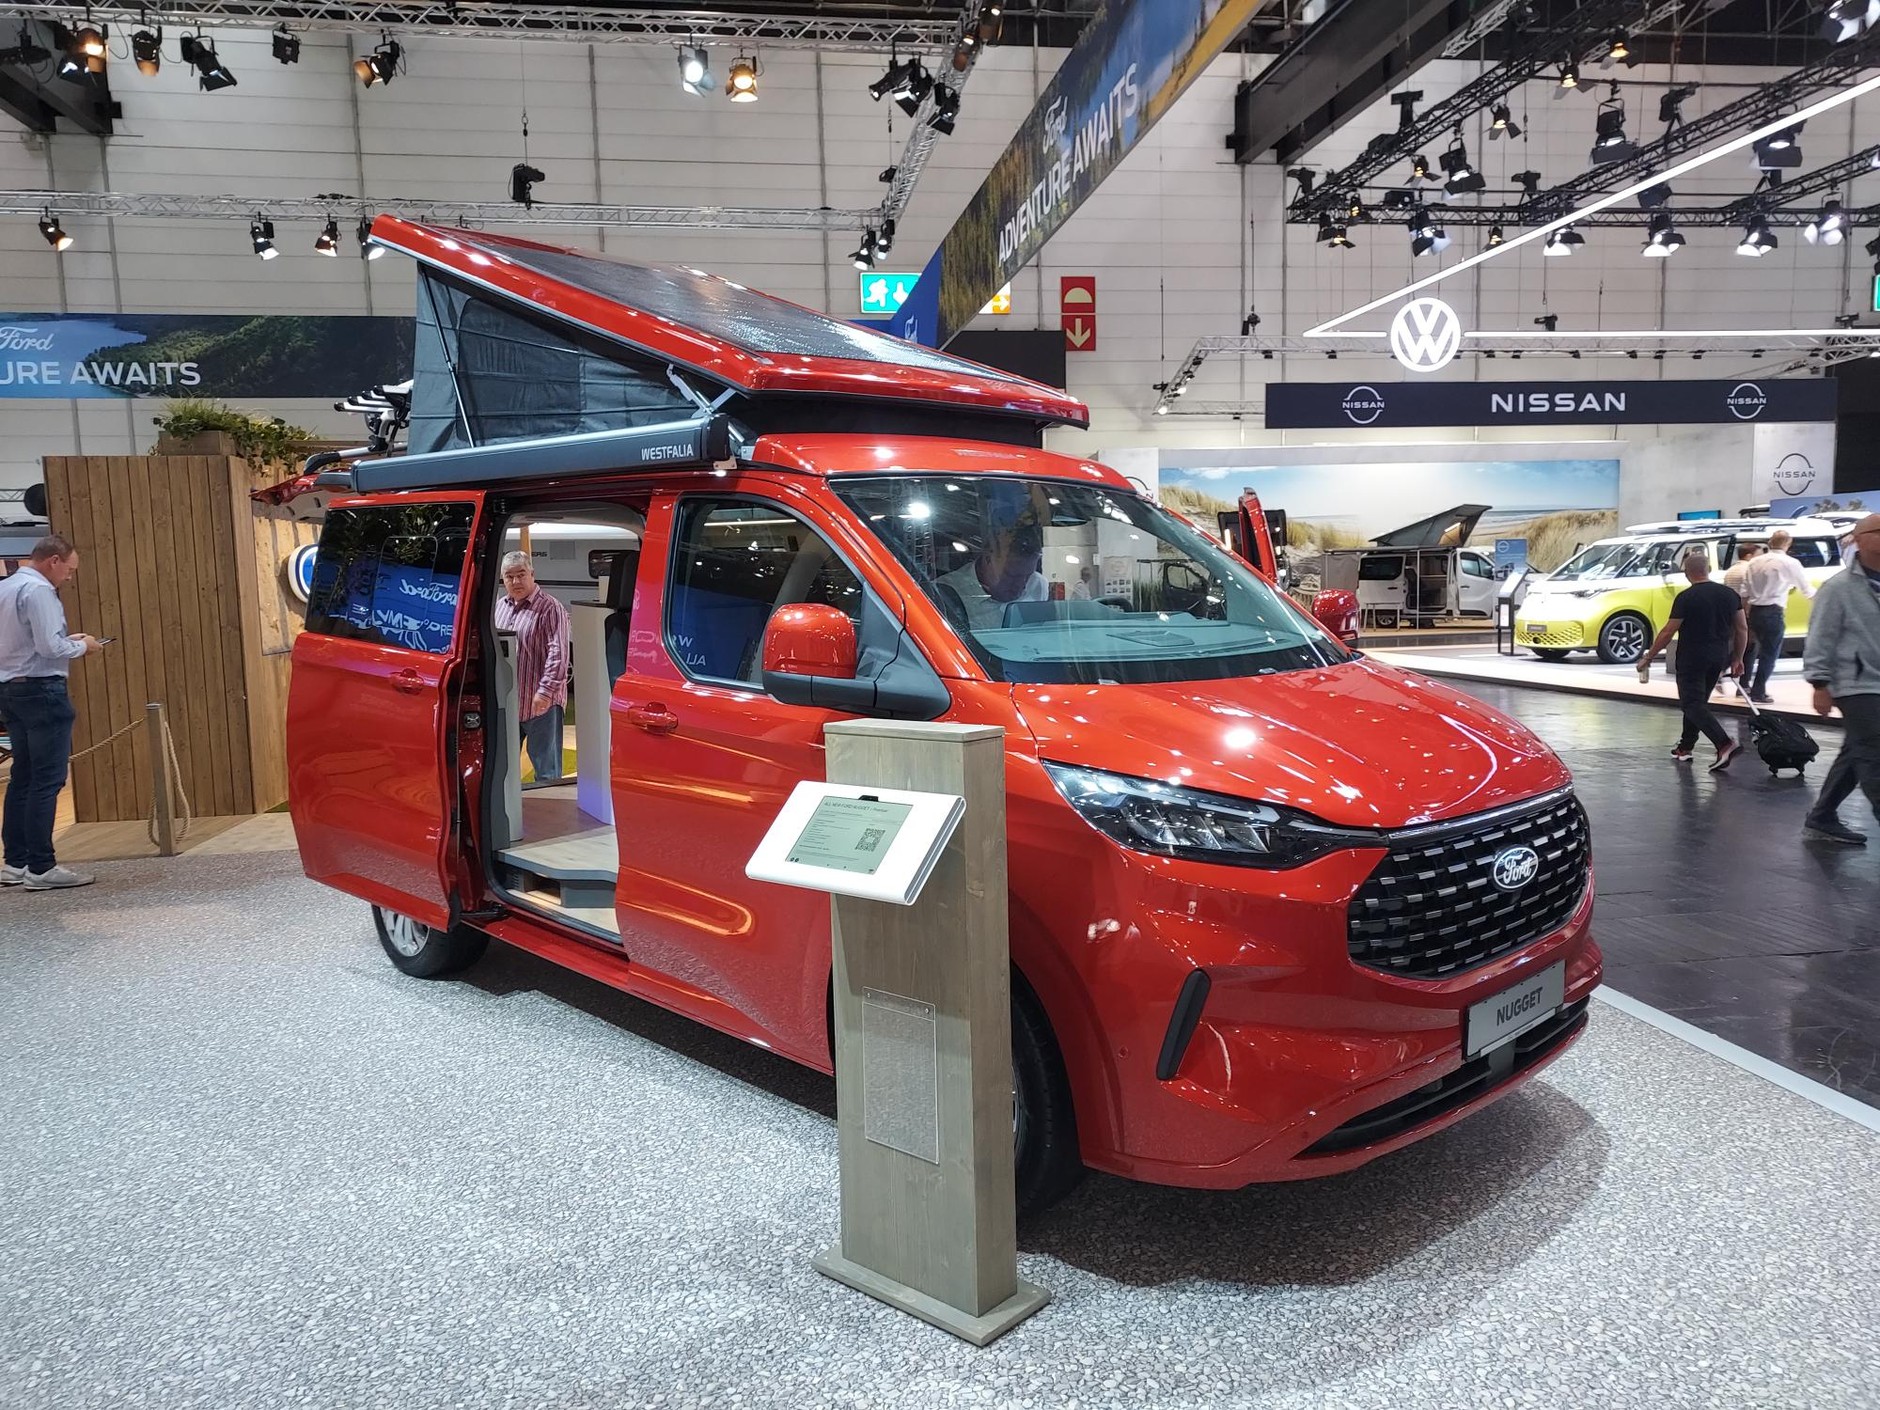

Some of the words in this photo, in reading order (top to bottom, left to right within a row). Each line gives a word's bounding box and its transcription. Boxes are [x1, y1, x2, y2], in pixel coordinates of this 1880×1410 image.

[1042, 95, 1068, 154] Ford
[998, 148, 1071, 268] ADVENTURE
[1073, 62, 1139, 182] AWAITS
[0, 326, 54, 350] Ford
[70, 361, 201, 386] AWAITS
[1342, 401, 1385, 410] NISSAN
[1491, 392, 1626, 413] NISSAN
[1726, 397, 1767, 405] NISSAN
[641, 443, 694, 461] WESTFALIA
[1773, 470, 1816, 479] NISSAN
[1503, 852, 1532, 884] Ford
[1496, 988, 1543, 1026] NUGGET
